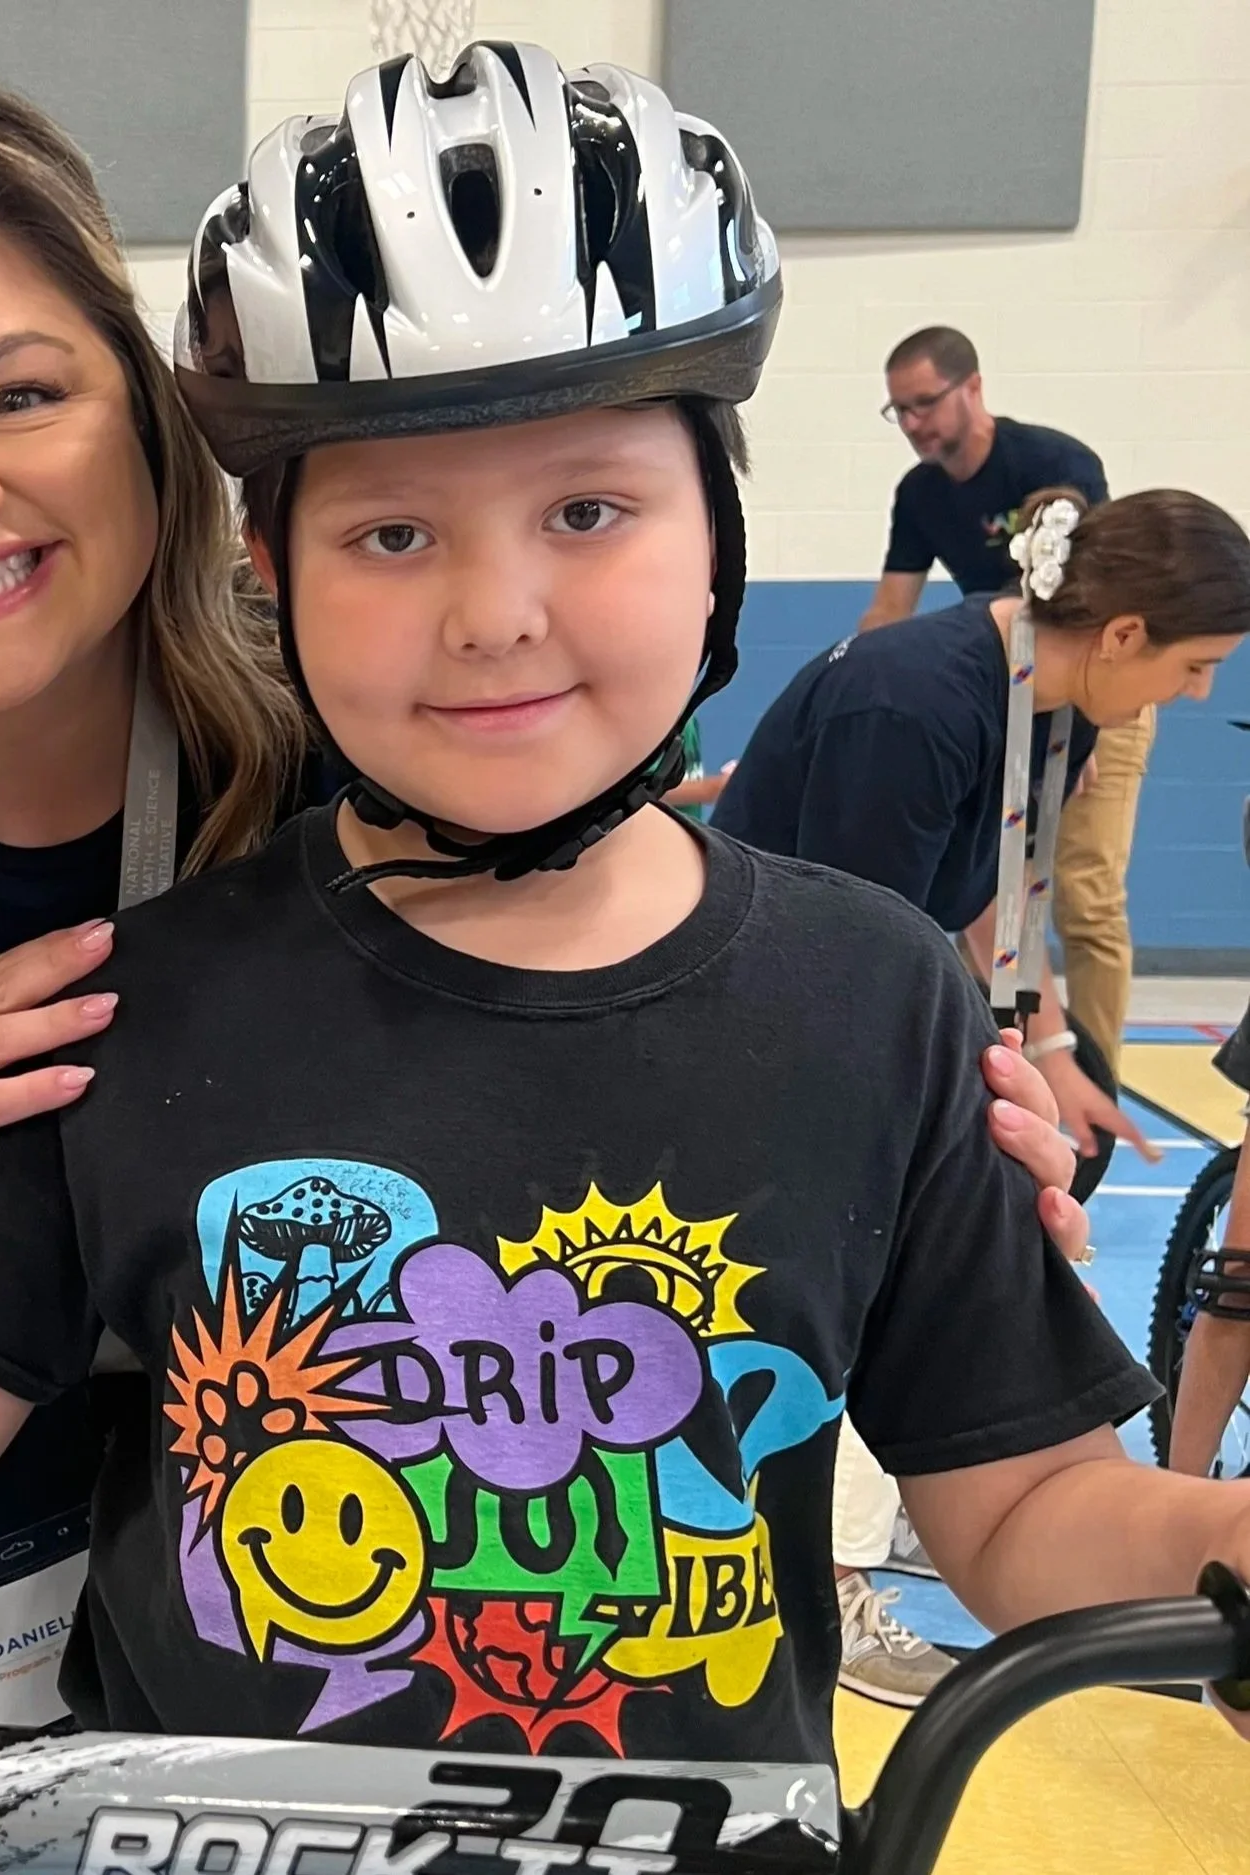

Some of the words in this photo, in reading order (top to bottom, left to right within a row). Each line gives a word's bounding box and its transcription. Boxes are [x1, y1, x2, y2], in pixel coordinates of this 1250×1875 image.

[144, 769, 161, 834] SCIENCE
[126, 818, 141, 895] NATIONAL
[142, 851, 155, 896] MATH
[157, 819, 173, 894] NITIATIVE
[388, 1761, 733, 1852] 20
